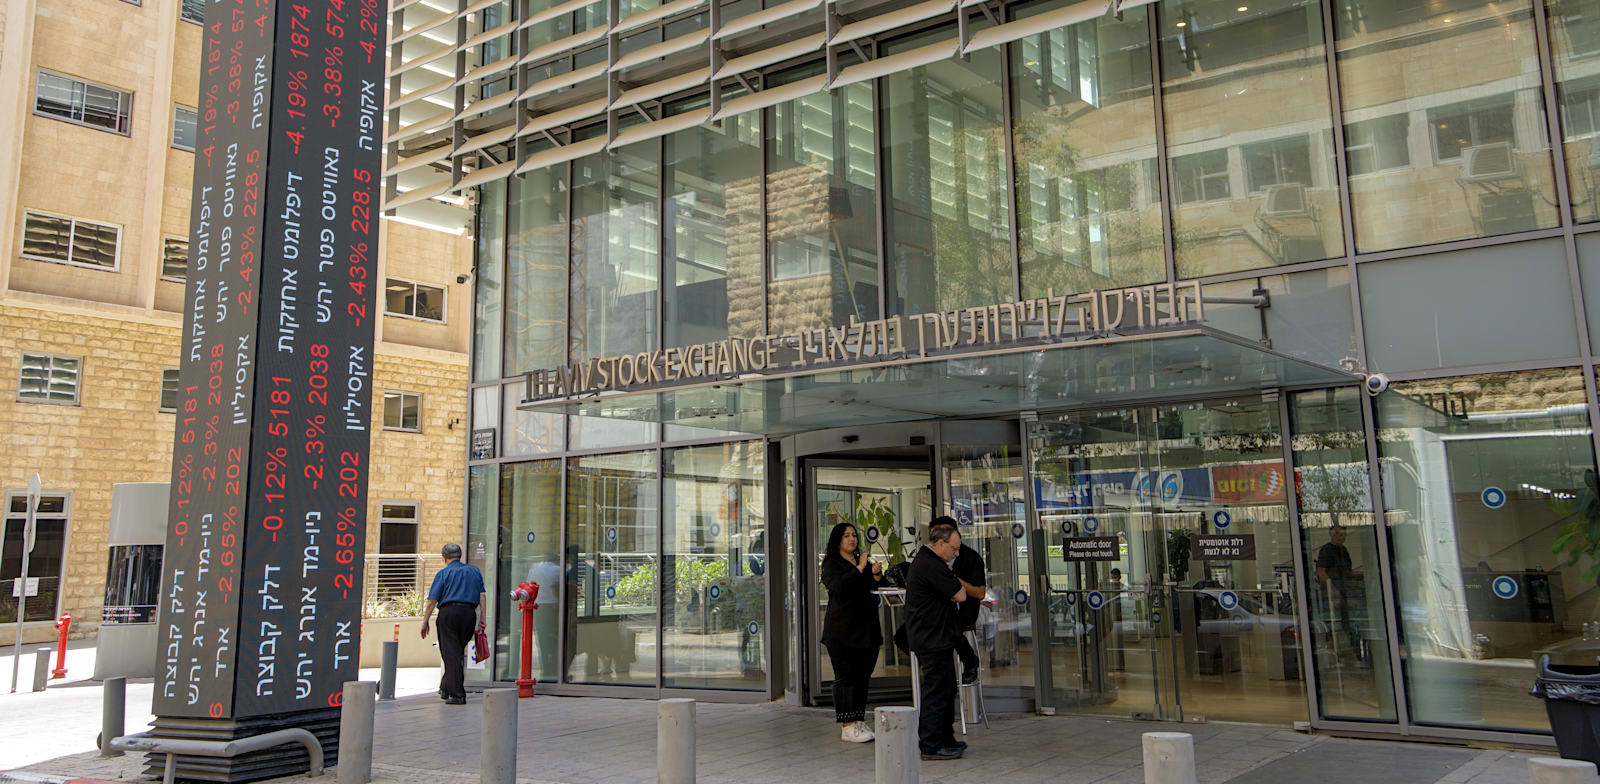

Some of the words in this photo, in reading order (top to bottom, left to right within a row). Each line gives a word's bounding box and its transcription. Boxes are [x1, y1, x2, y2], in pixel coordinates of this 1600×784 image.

[208, 22, 222, 75] 1874
[290, 4, 310, 58] 1874
[360, 0, 378, 63] -4.2%
[227, 40, 242, 122] -3.38%
[252, 55, 267, 128] אקופיה
[286, 71, 307, 154] -4.19%
[323, 47, 343, 128] -3.38%
[202, 86, 218, 167] -4.19%
[359, 80, 378, 150] אקופיה
[224, 144, 237, 217] נאוויטס
[243, 150, 260, 216] 228.5
[322, 148, 339, 220] נאוויטס
[352, 168, 371, 235] 228.5
[197, 187, 212, 270] דיפלומט
[281, 172, 302, 259] דיפלומט
[220, 226, 231, 272] פטר
[238, 226, 255, 315] -2.43%
[319, 229, 334, 272] פטר
[217, 281, 228, 322] יהש
[279, 269, 299, 353] אחזקות
[317, 282, 332, 322] יהש
[348, 243, 368, 327] -2.43%
[966, 288, 1067, 345] לניירות
[1078, 280, 1203, 331] הבורסה
[191, 280, 206, 360] אחזקות
[909, 310, 960, 358] ערך
[208, 344, 224, 405] 2038
[308, 344, 329, 405] 2038
[521, 369, 553, 399] TEL
[553, 358, 597, 396] AVIV
[597, 349, 662, 389] STOCK
[665, 334, 778, 379] EXCHANGE
[182, 386, 198, 443] 5181
[269, 377, 291, 437] 5181
[202, 416, 219, 491] -2.3%
[225, 448, 241, 495] 202
[304, 415, 325, 489] -2.3%
[339, 451, 359, 498] 202
[176, 454, 193, 547] -0.12%
[263, 448, 287, 542] -0.12%
[219, 506, 237, 602] -2.65%
[334, 507, 356, 599] -2.65%
[1069, 540, 1098, 549] Automatic
[1098, 540, 1112, 549] door
[1222, 547, 1230, 555] לא
[1231, 538, 1244, 546] דלת
[170, 571, 184, 613] דלק
[259, 565, 283, 609] דלק
[165, 625, 182, 696] קבוצה
[216, 628, 228, 677] ארד
[257, 622, 281, 696] קבוצה
[296, 653, 312, 699] יהש
[335, 621, 350, 669] ארד
[188, 658, 201, 704] יהש
